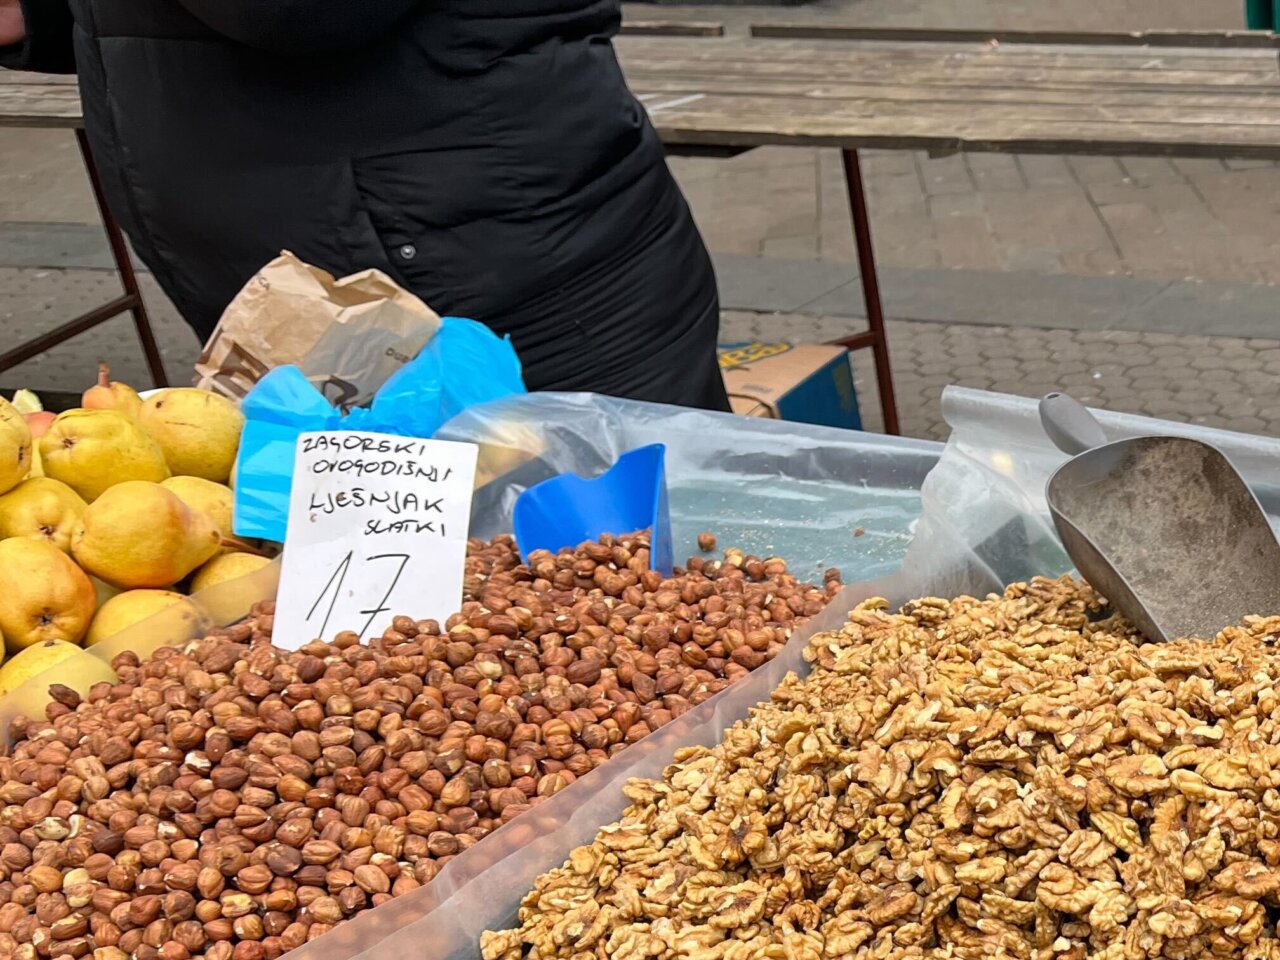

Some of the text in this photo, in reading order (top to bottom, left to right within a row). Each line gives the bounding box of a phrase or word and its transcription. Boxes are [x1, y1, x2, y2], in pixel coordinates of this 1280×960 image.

[302, 435, 426, 456] ZAGORSKI
[308, 487, 444, 514] LJEŠNJAK
[363, 519, 446, 537] SLATKI
[305, 549, 411, 639] 17
